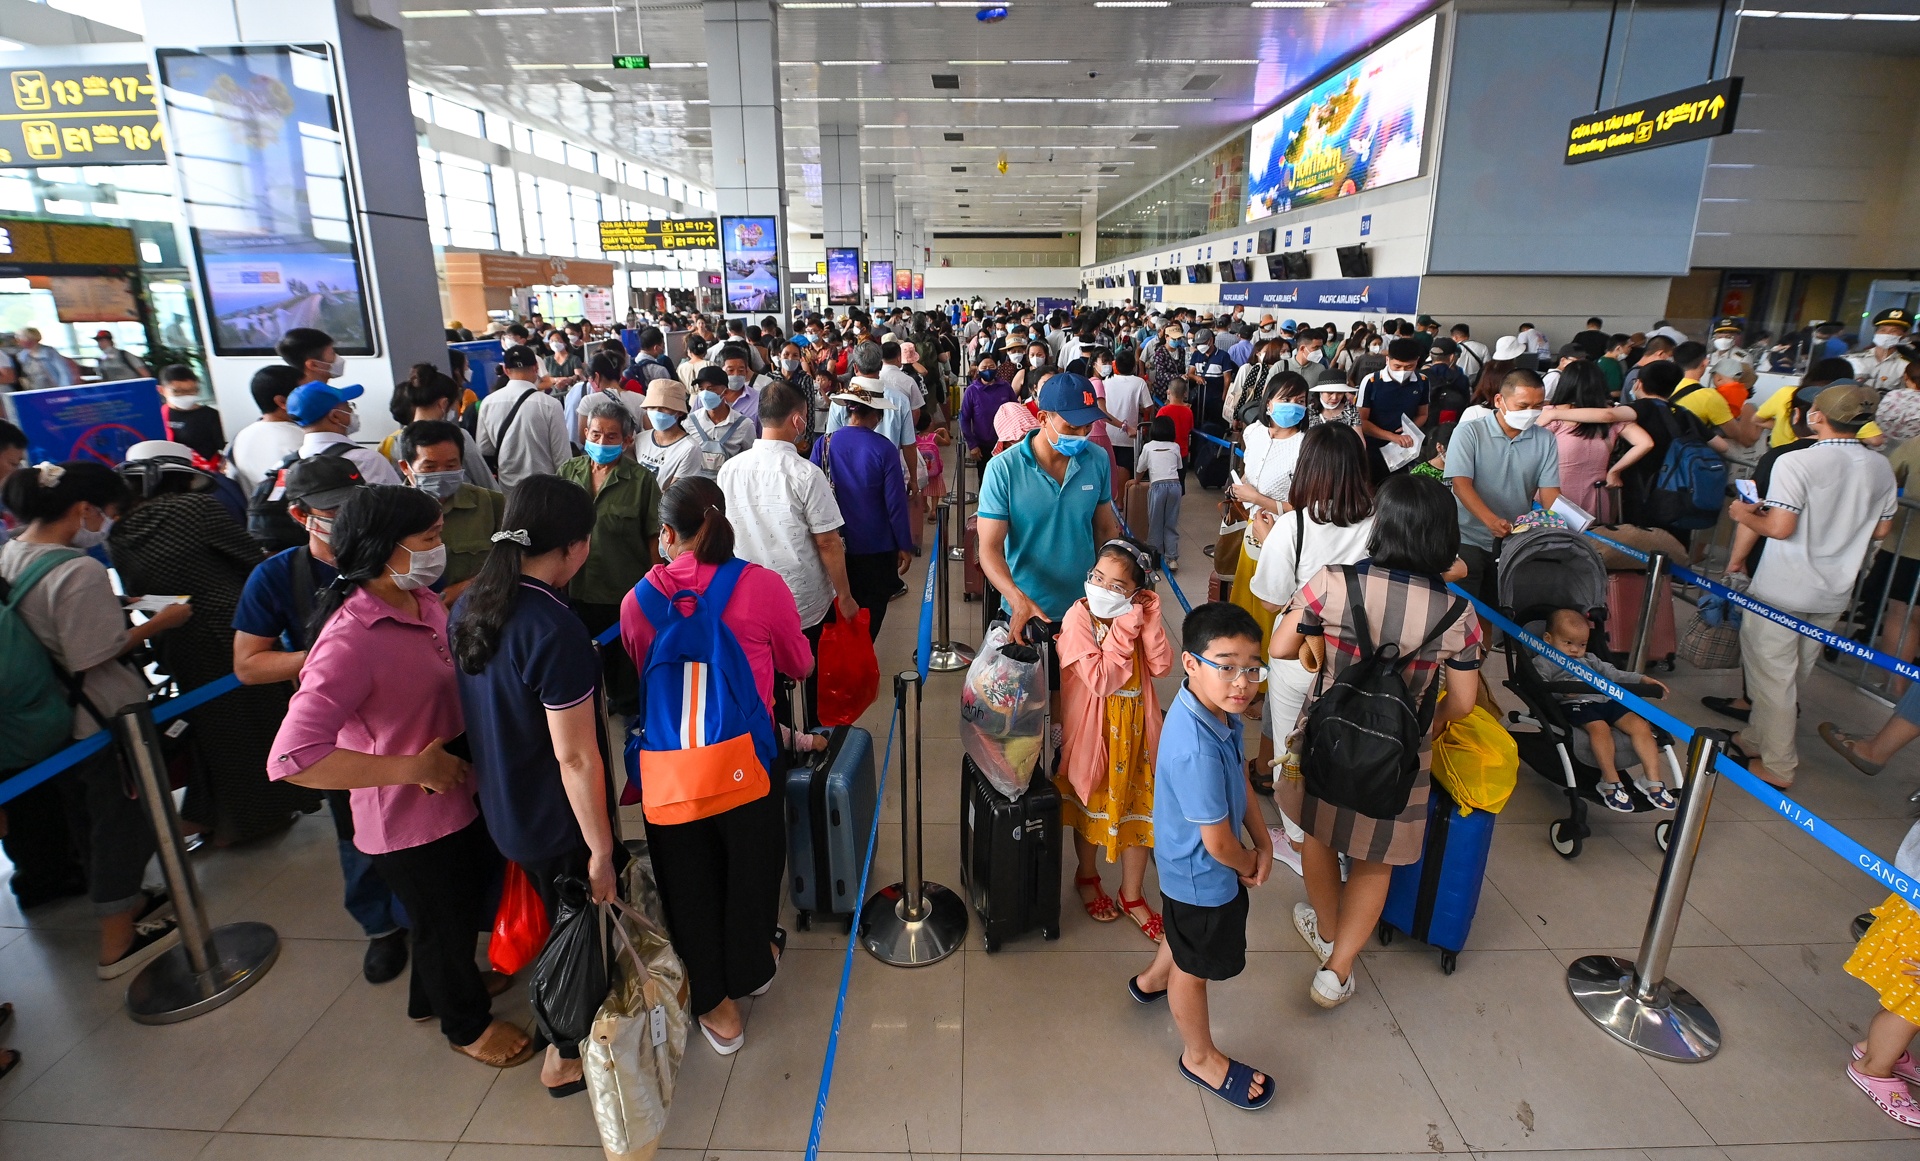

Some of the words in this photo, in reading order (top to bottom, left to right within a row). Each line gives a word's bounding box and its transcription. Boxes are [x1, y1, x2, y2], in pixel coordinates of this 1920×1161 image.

[51, 79, 84, 105] 13
[109, 76, 139, 102] 17
[1656, 109, 1674, 131] 13
[1689, 99, 1710, 123] 17
[61, 127, 94, 152] E1
[119, 125, 151, 150] 18
[674, 222, 685, 231] 13
[694, 221, 703, 231] 17
[1319, 294, 1337, 304] PACIFIC
[1337, 294, 1361, 304] AIRLINES
[1747, 601, 1770, 617] HÀNG
[1837, 640, 1855, 653] NỘI
[1856, 647, 1874, 661] BÀI
[1894, 662, 1920, 680] N.I.A
[1518, 631, 1529, 643] AN
[1528, 637, 1546, 652] NINH
[1545, 647, 1566, 666] HÀNG
[1565, 659, 1593, 682] KHÔNG
[1593, 675, 1608, 692] NỘI
[1608, 685, 1624, 701] BÀI
[1779, 800, 1814, 831] N.I.A
[1859, 854, 1909, 893] CẢNG
[1868, 1090, 1907, 1123] crocs
